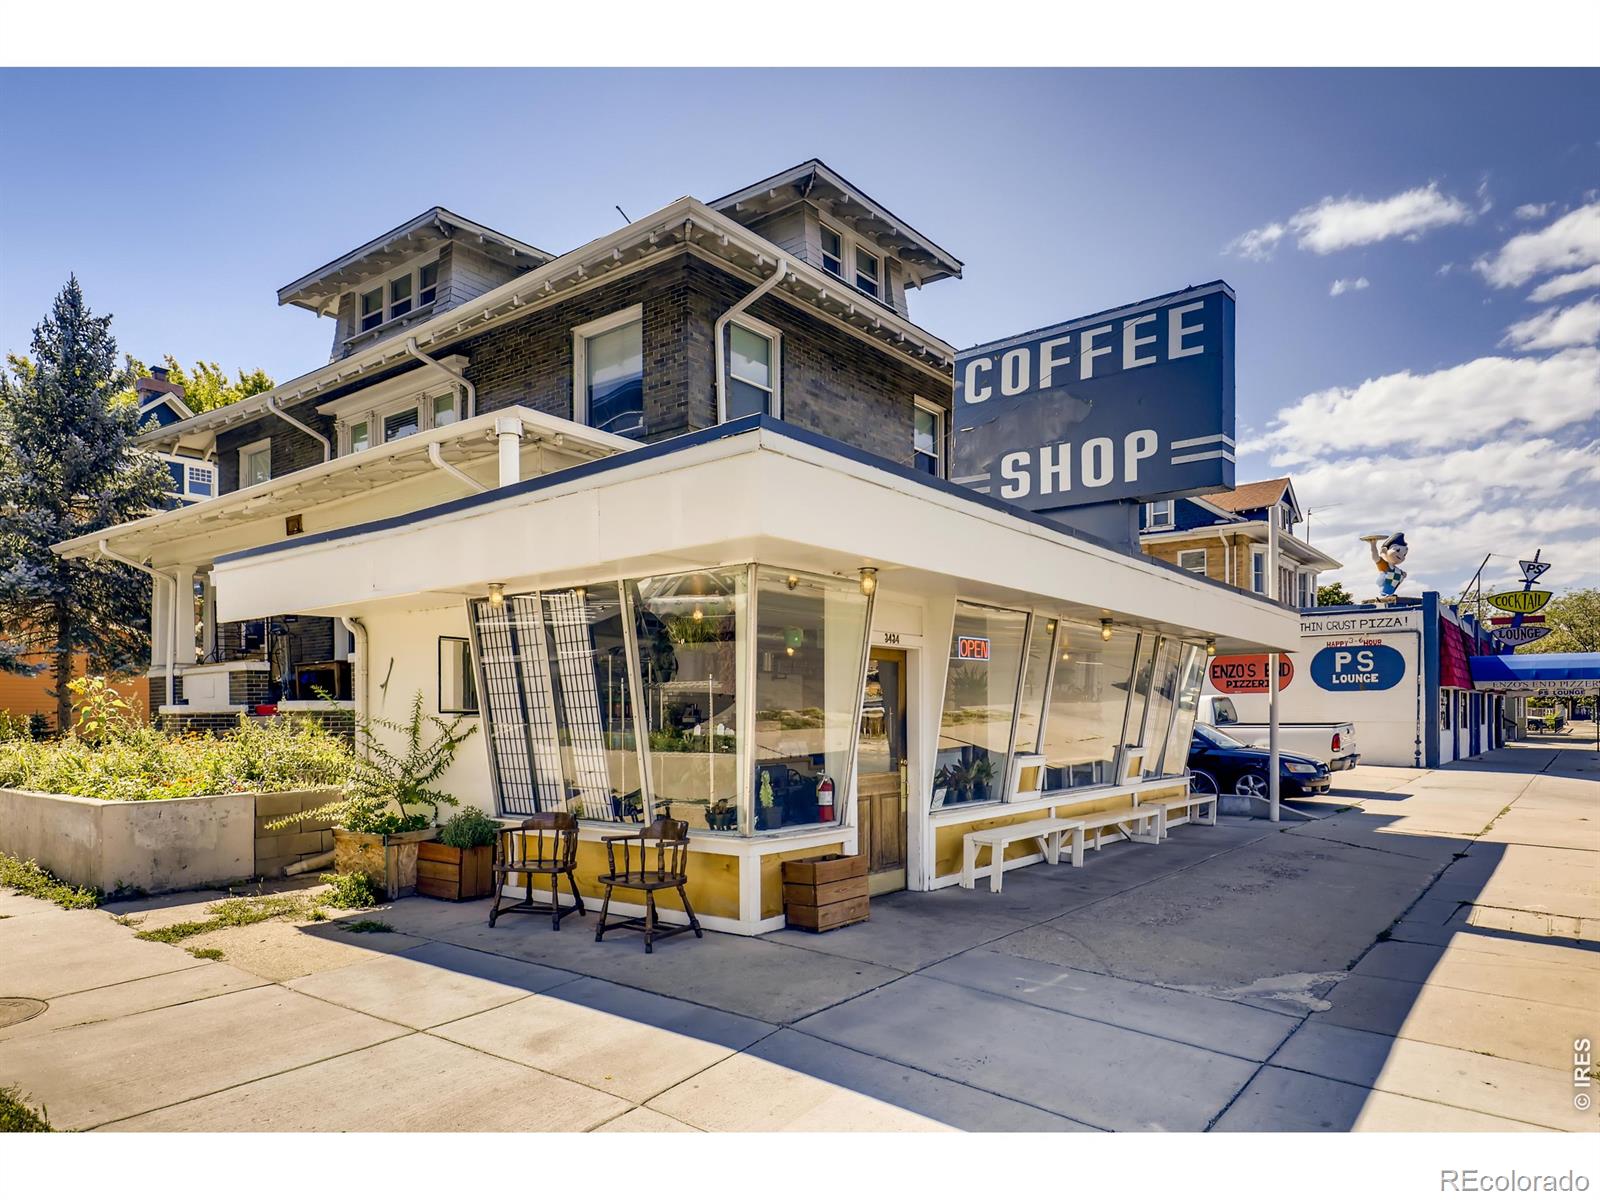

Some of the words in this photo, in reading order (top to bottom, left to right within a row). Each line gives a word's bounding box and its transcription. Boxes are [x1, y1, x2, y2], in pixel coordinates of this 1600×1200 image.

[964, 301, 1204, 404] COFFEE
[1000, 429, 1158, 499] SHOP
[1526, 564, 1544, 574] PS
[1495, 593, 1542, 610] COCKTAIL
[1300, 622, 1323, 632] THIN
[1326, 620, 1357, 630] CRUST
[1359, 616, 1409, 629] PIZZA!
[885, 633, 899, 644] 3434
[1499, 628, 1541, 640] LOUNGE
[959, 639, 989, 659] OPEN
[1326, 640, 1349, 648] HAPPY
[1335, 650, 1375, 673] PS
[1212, 663, 1256, 679] ENZO'S
[1226, 680, 1270, 689] PIZZERI
[1332, 673, 1379, 684] LOUNGE
[1559, 680, 1600, 688] PIZZER
